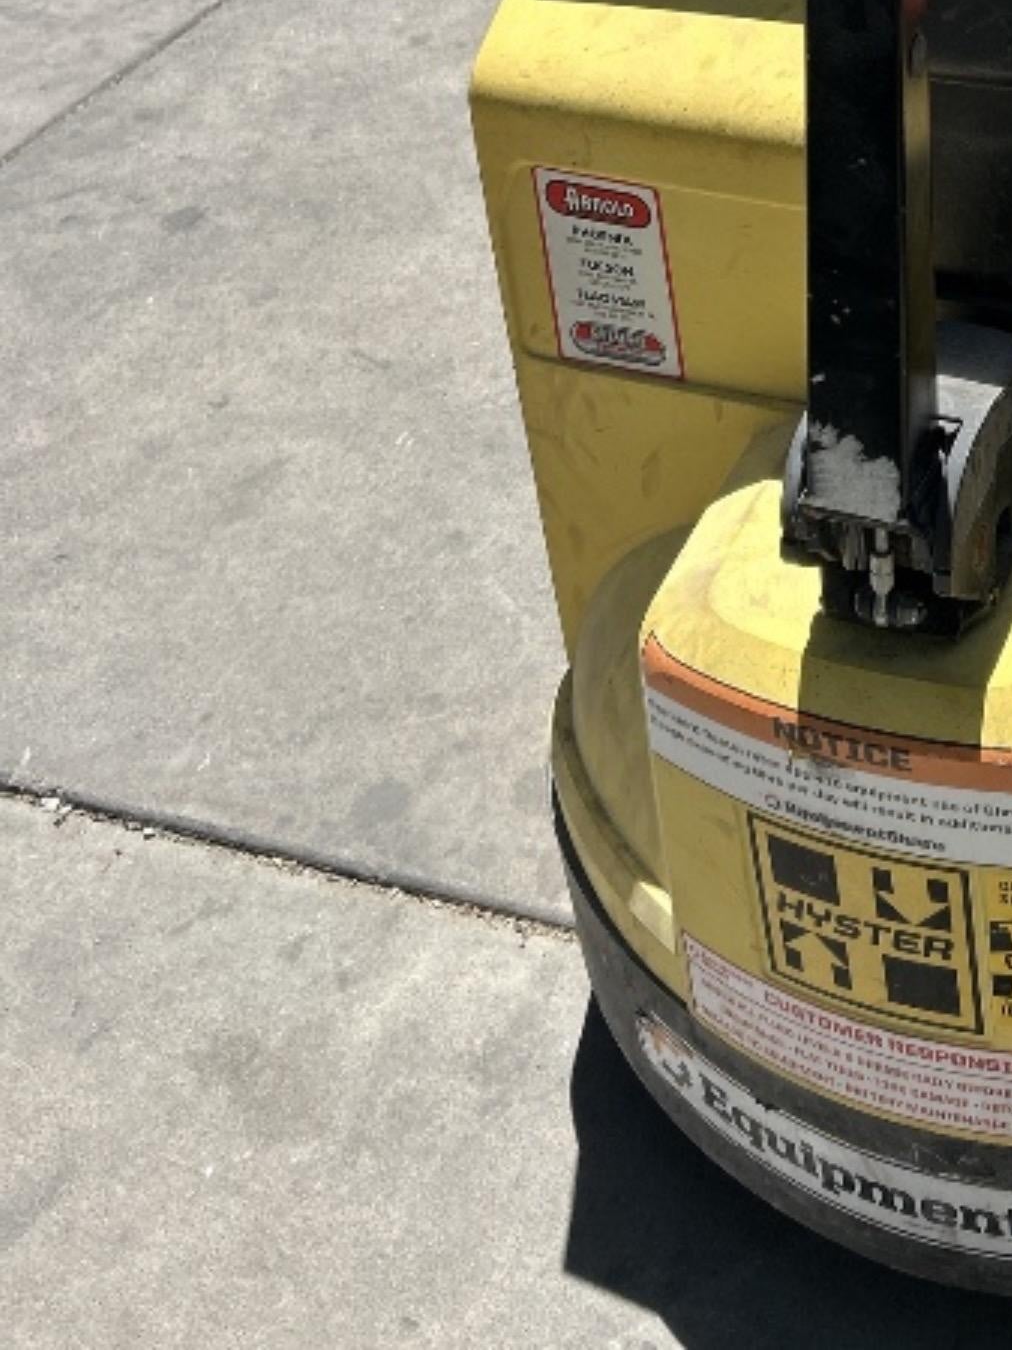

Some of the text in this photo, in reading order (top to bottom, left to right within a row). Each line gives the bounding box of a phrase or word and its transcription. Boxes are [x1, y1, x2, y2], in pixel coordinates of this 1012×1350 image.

[773, 716, 913, 772] NOTICE
[776, 891, 955, 960] HYSTER
[764, 990, 883, 1048] CUSTOMER
